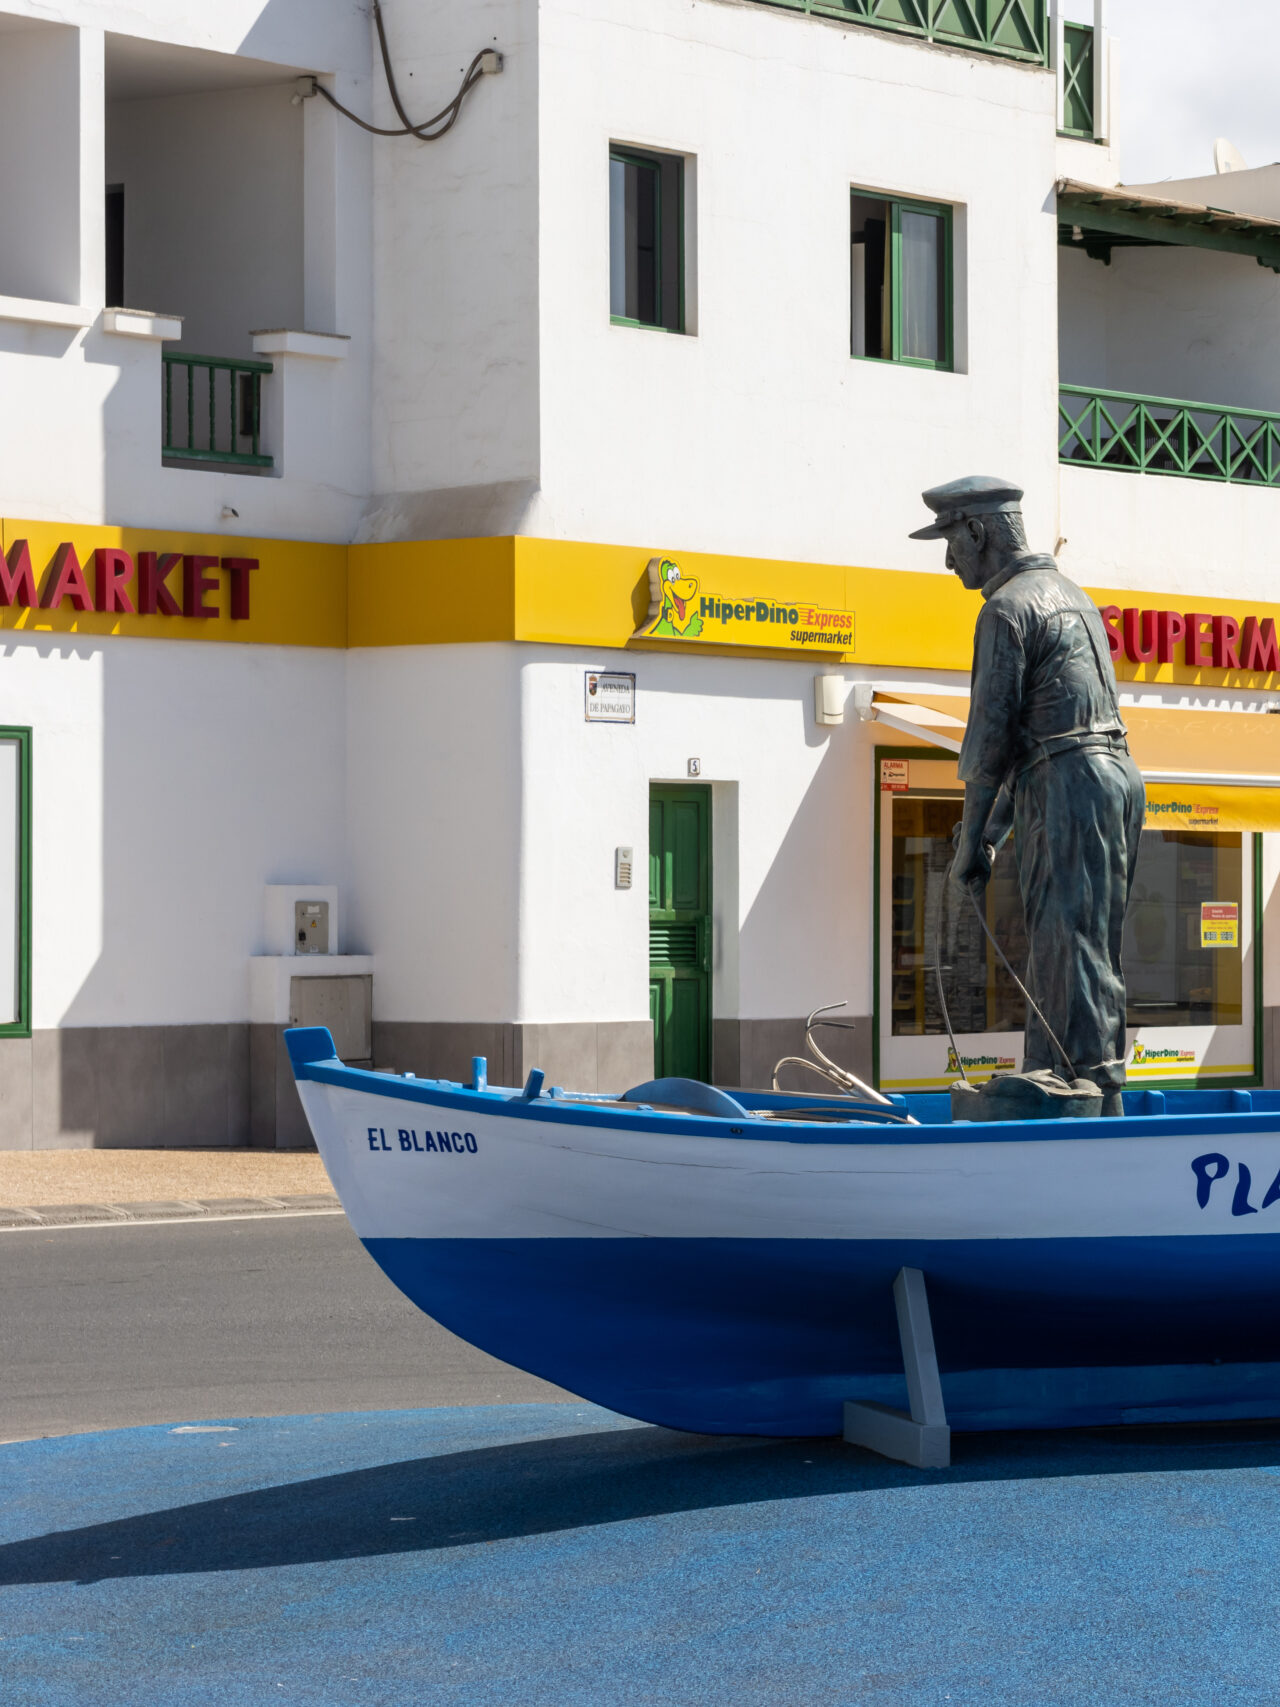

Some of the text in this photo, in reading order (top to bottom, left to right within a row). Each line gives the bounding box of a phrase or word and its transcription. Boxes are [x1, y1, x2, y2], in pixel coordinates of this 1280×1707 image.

[0, 539, 259, 620] MARKET
[700, 597, 853, 630] HiperDino Express
[790, 629, 853, 645] supermarket
[601, 684, 630, 694] AVENIDA
[590, 702, 631, 713] DE PAPAGAYO
[367, 1128, 478, 1154] EL BLANCO
